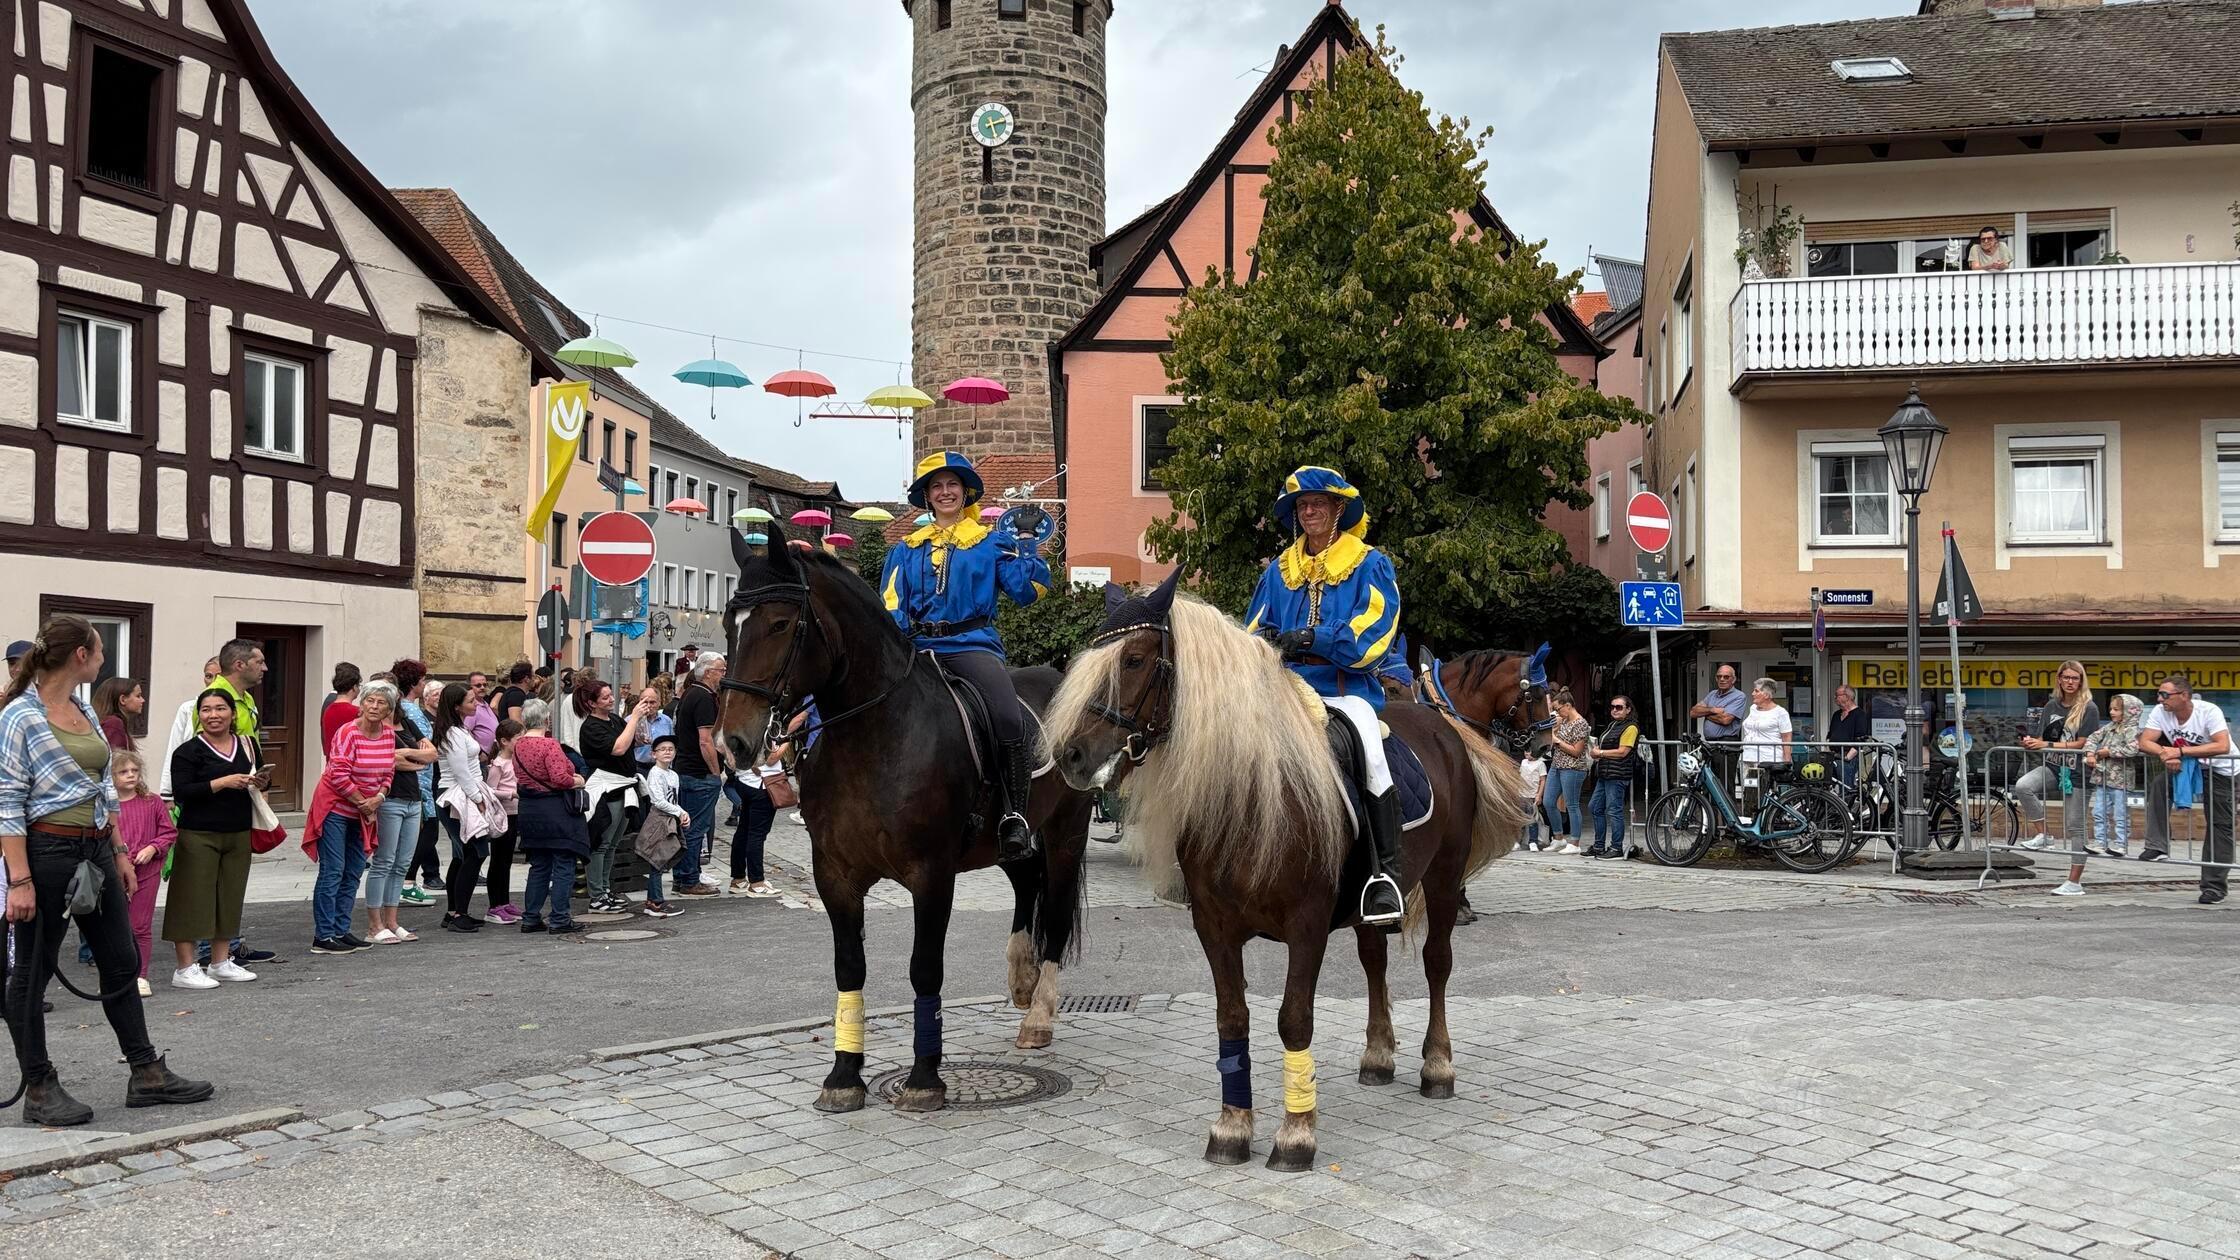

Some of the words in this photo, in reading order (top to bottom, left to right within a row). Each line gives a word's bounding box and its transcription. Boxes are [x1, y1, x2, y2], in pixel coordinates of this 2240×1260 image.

[1827, 592, 1869, 603] Sonnenstr.
[1862, 664, 2006, 686] Reiebüro
[2018, 669, 2058, 686] am
